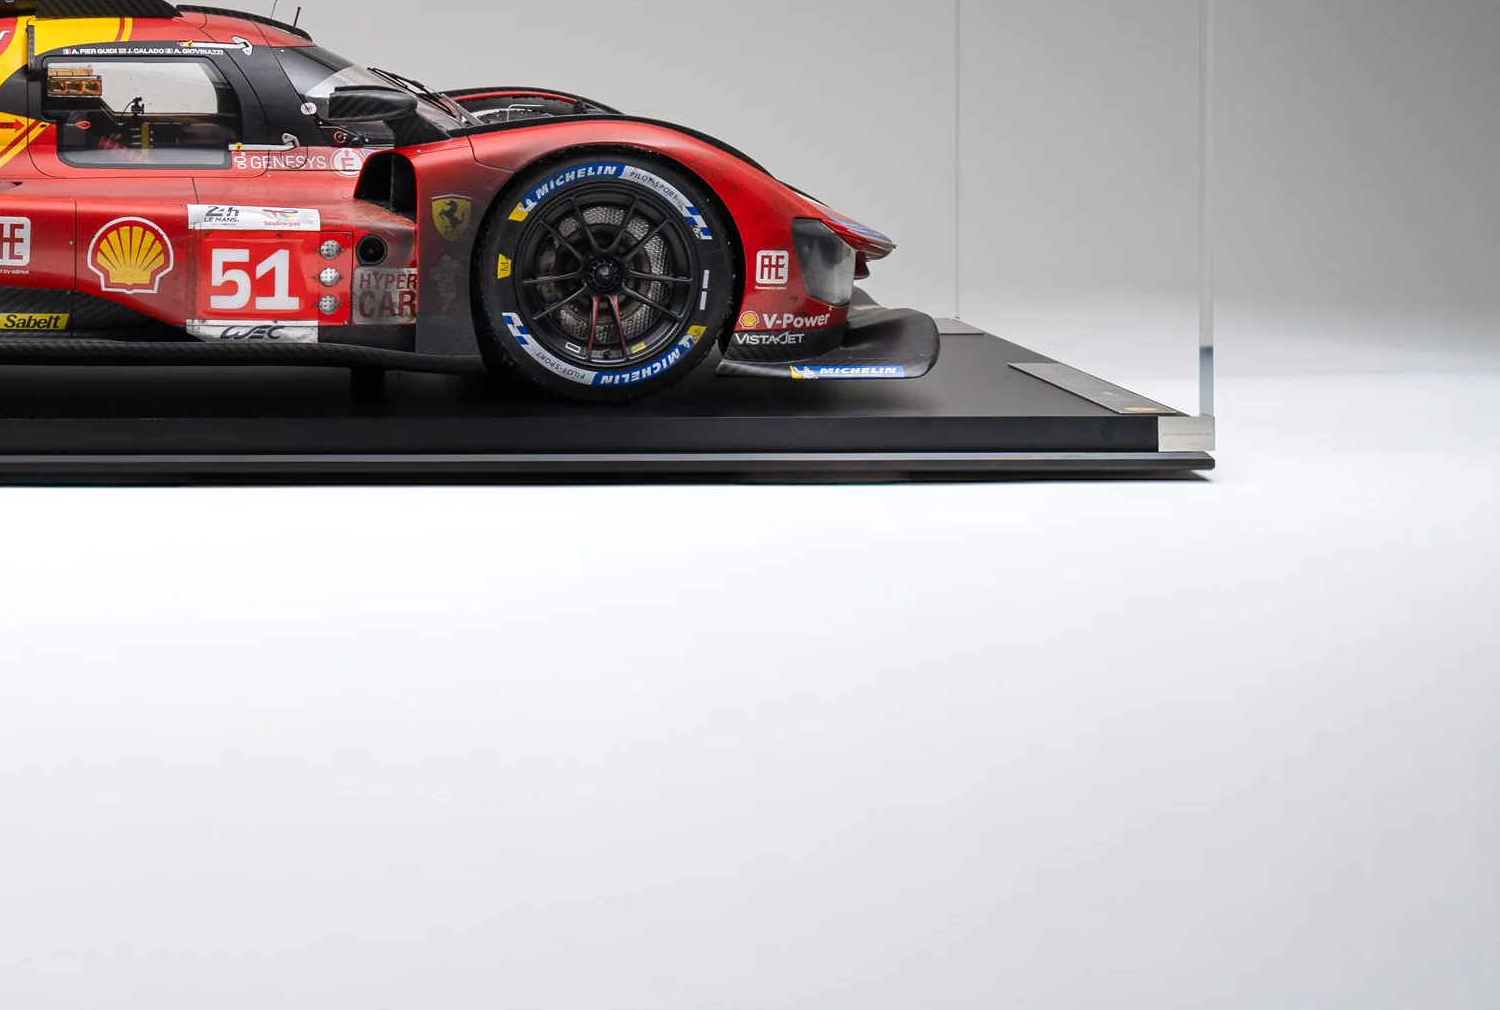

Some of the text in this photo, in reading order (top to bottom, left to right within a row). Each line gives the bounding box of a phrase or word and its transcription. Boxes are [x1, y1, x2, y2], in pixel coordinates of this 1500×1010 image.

[182, 48, 223, 56] GIOVINAZZI
[250, 155, 327, 169] GENESYS
[535, 165, 617, 200] MICHELIN
[209, 248, 300, 311] 51
[359, 273, 417, 290] HYPER
[358, 290, 417, 319] CAR
[3, 314, 61, 329] Sabelt
[762, 312, 831, 329] V-Power
[600, 348, 681, 385] MICHELIN
[819, 367, 897, 375] MICHELIN
